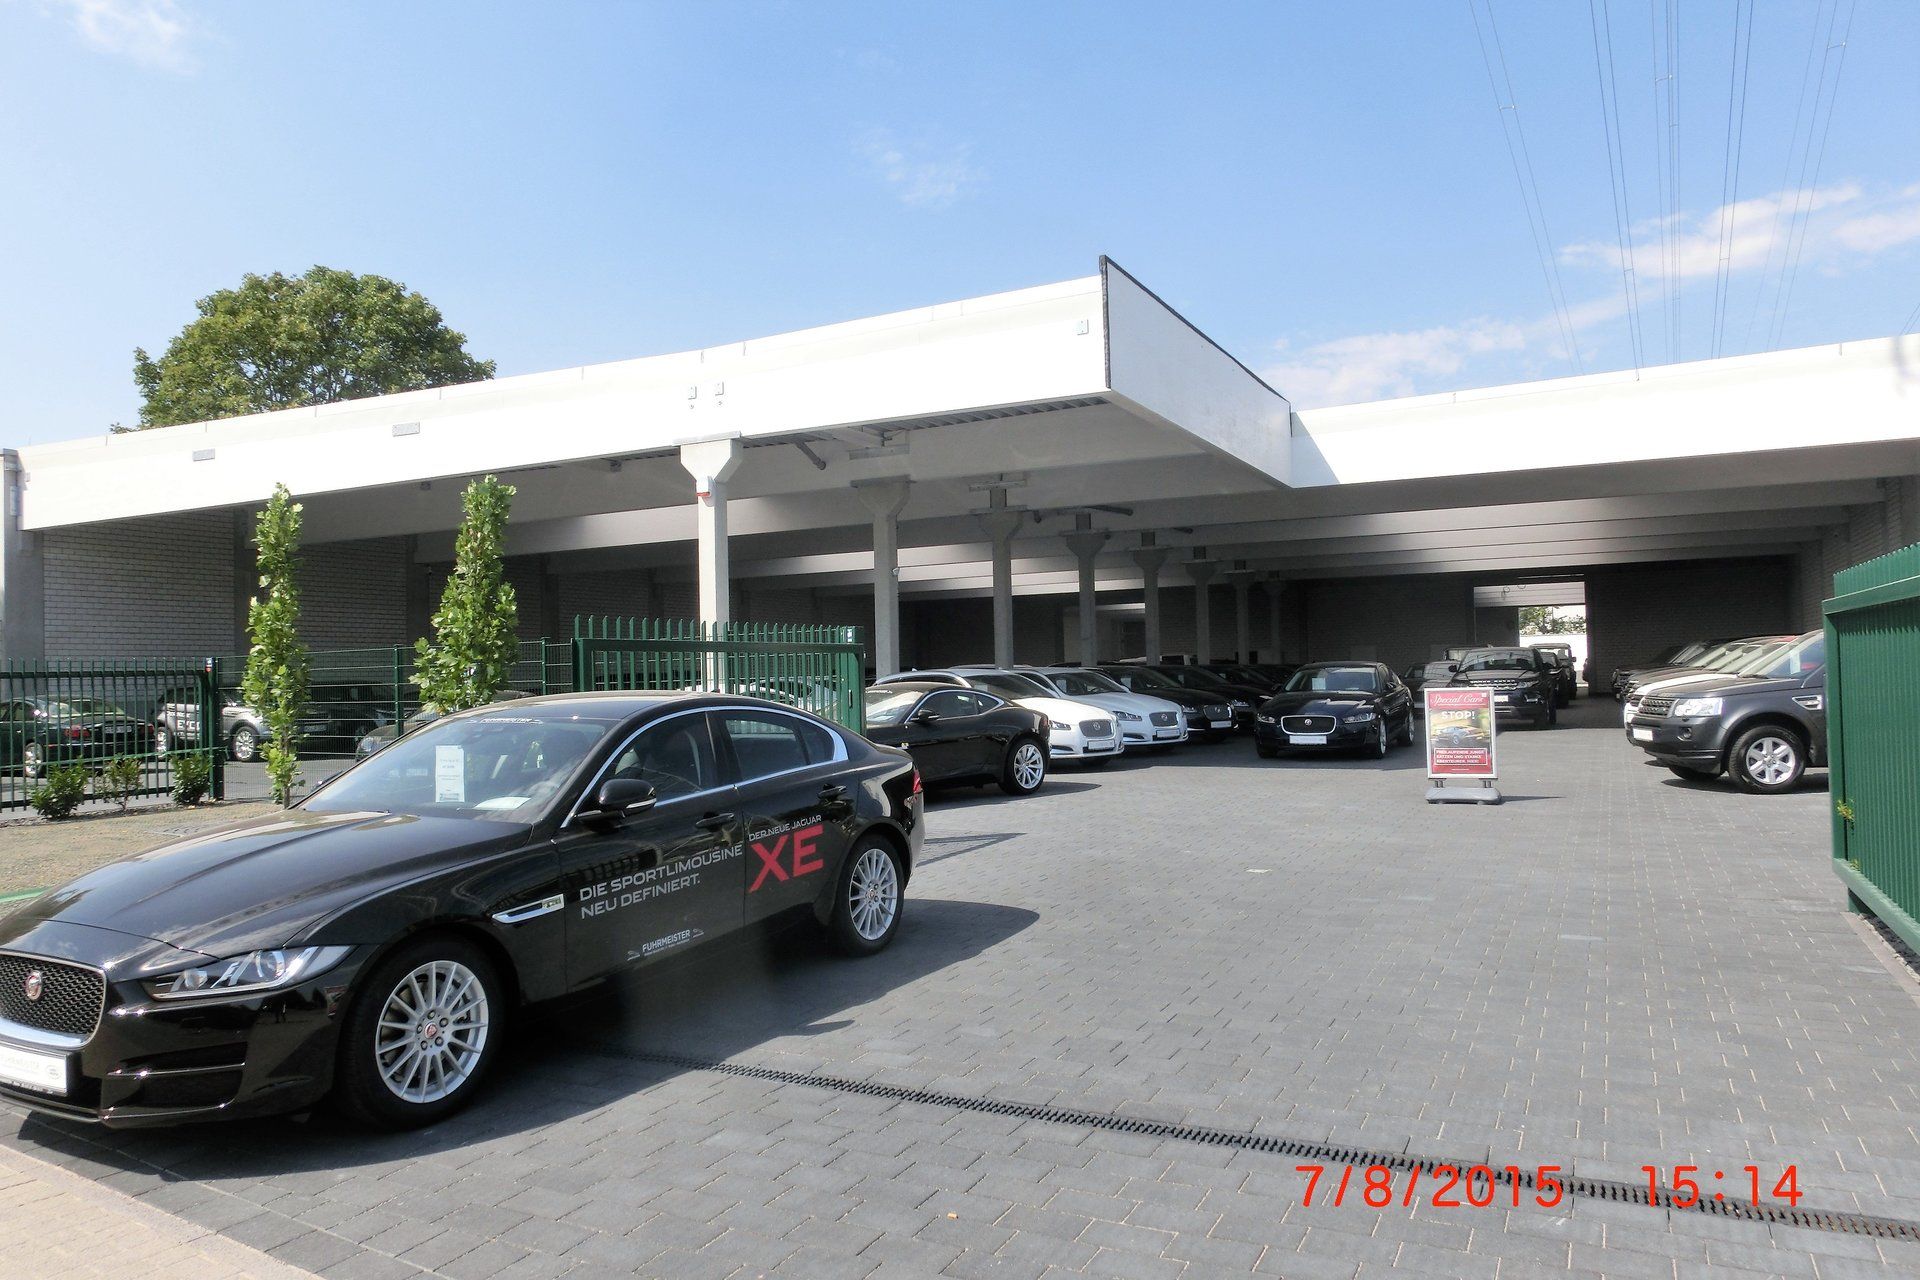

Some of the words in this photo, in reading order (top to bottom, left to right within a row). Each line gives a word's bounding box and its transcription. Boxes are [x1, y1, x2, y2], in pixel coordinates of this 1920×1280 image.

[1441, 710, 1476, 720] STOP!
[748, 831, 768, 842] DER
[767, 823, 791, 837] NEUE
[791, 814, 822, 830] JAGUAR
[579, 882, 608, 901] DIE
[611, 844, 743, 892] SPORTLIMOUSINE
[748, 824, 824, 893] XE
[581, 897, 618, 919] NEU
[620, 873, 701, 907] DEFINIERT.
[642, 929, 691, 952] FUHRMEISTER
